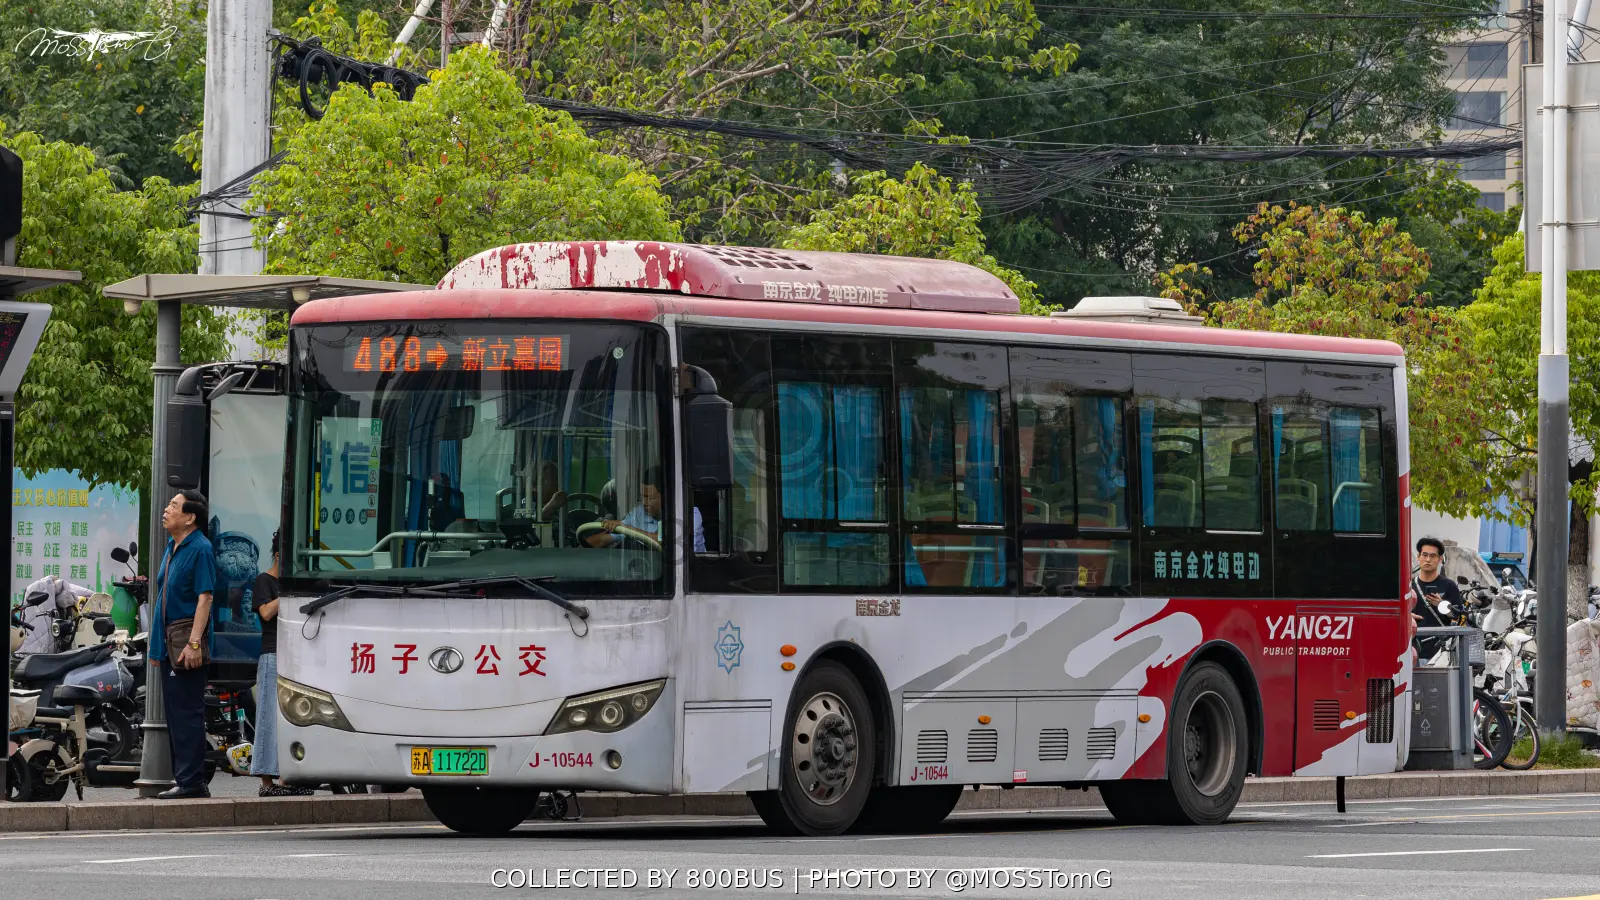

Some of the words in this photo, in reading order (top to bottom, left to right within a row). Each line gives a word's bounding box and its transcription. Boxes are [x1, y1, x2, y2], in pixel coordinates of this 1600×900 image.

[761, 280, 822, 301] 南京金龙
[827, 284, 889, 305] 纯电动车
[354, 336, 420, 371] 488
[462, 336, 562, 371] 新立嘉园
[12, 488, 89, 507] 主义核心价值观
[17, 521, 34, 536] 民主
[43, 521, 61, 536] 文明
[70, 521, 88, 537] 和谐
[16, 542, 33, 557] 平等
[43, 542, 60, 558] 公正
[70, 543, 88, 558] 法治
[16, 564, 33, 579] 敬业
[70, 564, 88, 579] 友善
[1154, 550, 1260, 580] 南京金龙纯电动
[1265, 615, 1354, 640] YANGZI
[351, 642, 418, 674] 扬子
[474, 644, 546, 677] 公交
[1262, 646, 1294, 656] PUBLIC
[1298, 646, 1350, 656] TRANSPORT
[529, 752, 593, 768] J-10544
[910, 765, 949, 781] J-10544
